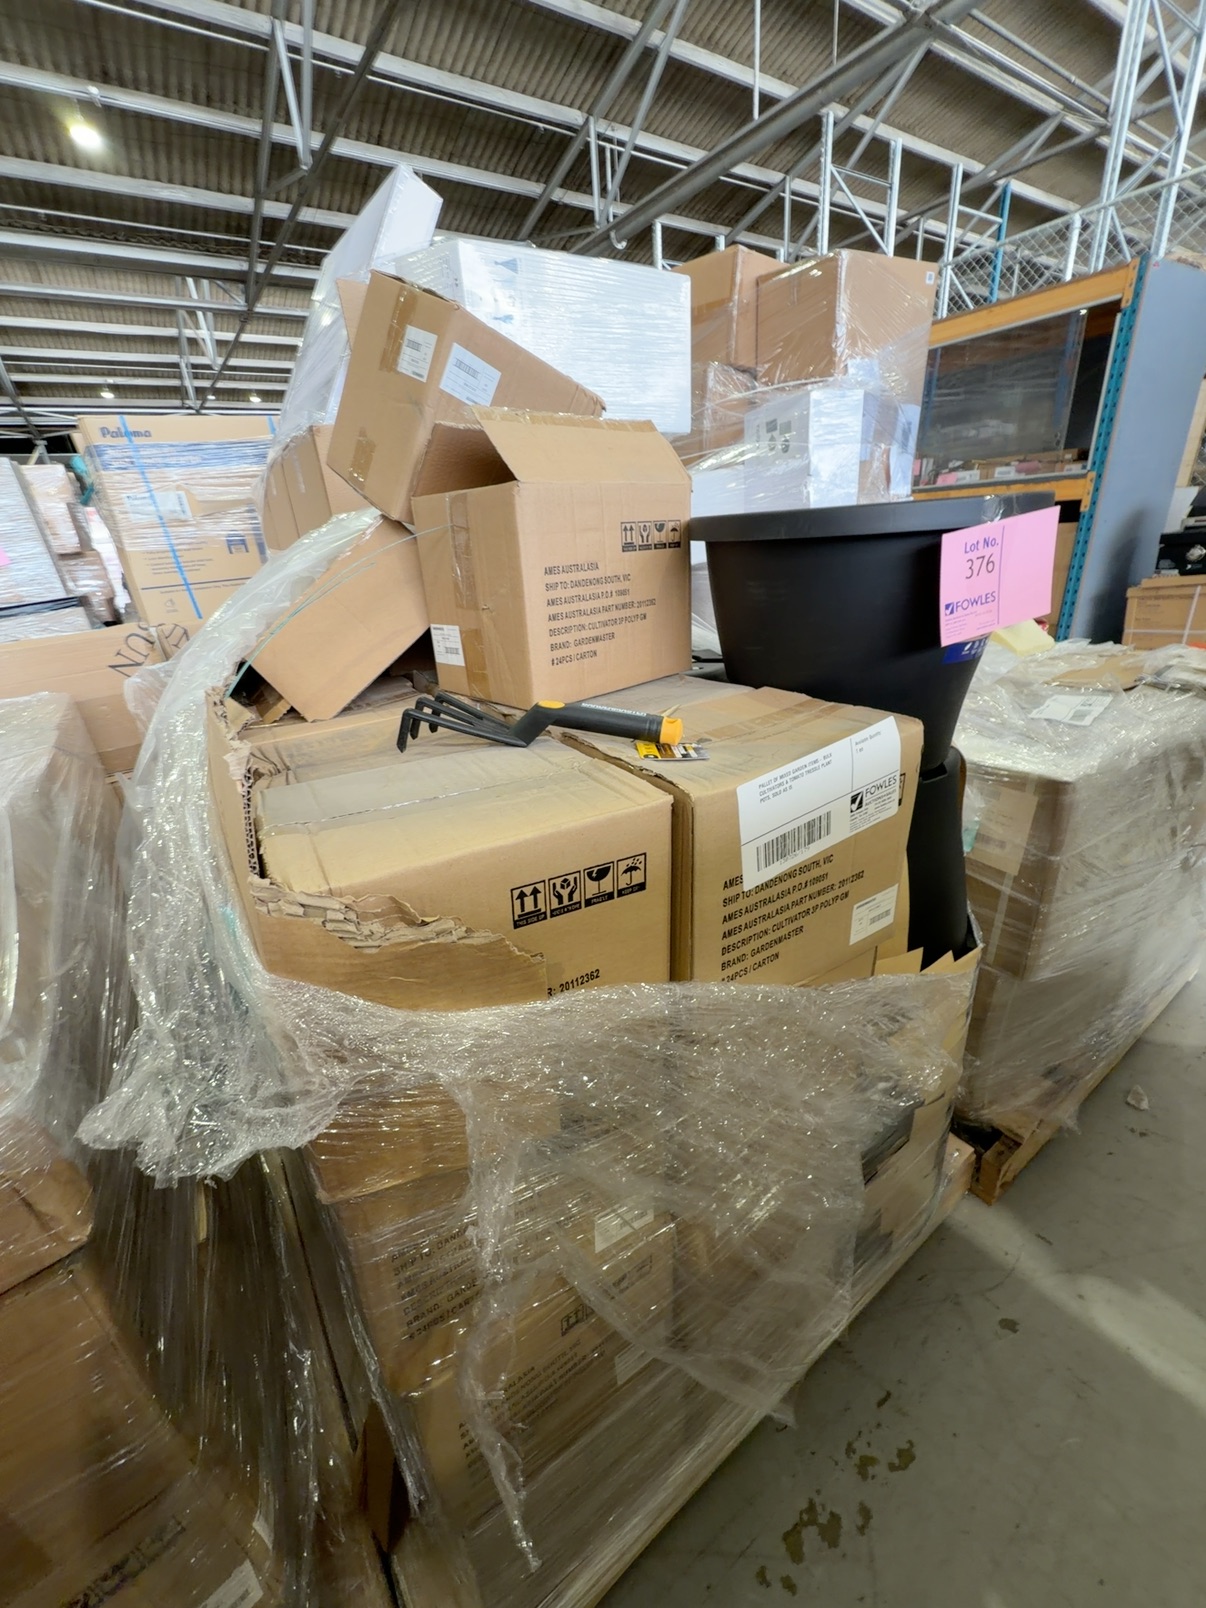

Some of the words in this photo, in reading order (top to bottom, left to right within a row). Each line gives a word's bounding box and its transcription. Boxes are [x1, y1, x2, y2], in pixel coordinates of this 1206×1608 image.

[964, 540, 979, 554] Lot
[983, 537, 999, 549] No.
[544, 566, 560, 576] AMES
[562, 562, 599, 574] AUSTRALASIA
[966, 554, 995, 579] 376
[545, 583, 559, 592] SHIP
[560, 581, 570, 590] TO:
[571, 577, 604, 589] DANDENONG
[622, 573, 631, 582] VIC
[547, 597, 563, 607] AMES
[564, 592, 600, 604] AUSTRALASIA
[956, 591, 996, 612] FOWLES
[548, 613, 564, 622] AMES
[565, 606, 601, 620] AUSTRALASIA
[602, 604, 614, 613] PART
[549, 625, 588, 637] DESCRIPTION:
[588, 618, 619, 631] CULTIVATOR
[550, 641, 571, 652] BRAND:
[574, 632, 615, 647] GARDENMASTER
[576, 650, 597, 661] CARTON
[866, 776, 897, 798] FOWLES
[723, 894, 740, 908] SHIP
[741, 890, 754, 900] TO:
[755, 869, 797, 895] DANDENONG
[798, 860, 822, 875] SOUTH,
[823, 854, 834, 866] VIC
[723, 875, 743, 891] AMES
[722, 926, 743, 940] AMES
[744, 904, 791, 932] AUSTRALASIA
[791, 897, 808, 910] PART
[808, 884, 838, 902] NUMBER:
[838, 870, 865, 890] 20112362
[722, 909, 743, 925] AMES
[744, 888, 791, 916] AUSTRALASIA
[722, 928, 771, 956] DESCRIPTION:
[772, 907, 811, 932] CULTIVATOR
[812, 903, 819, 915] 3P
[820, 896, 840, 911] POLYP
[840, 890, 850, 903] GM
[721, 954, 749, 972] BRAND:
[751, 926, 804, 958] GARDENMASTER
[752, 952, 780, 971] CARTON
[559, 969, 600, 993] 20112362
